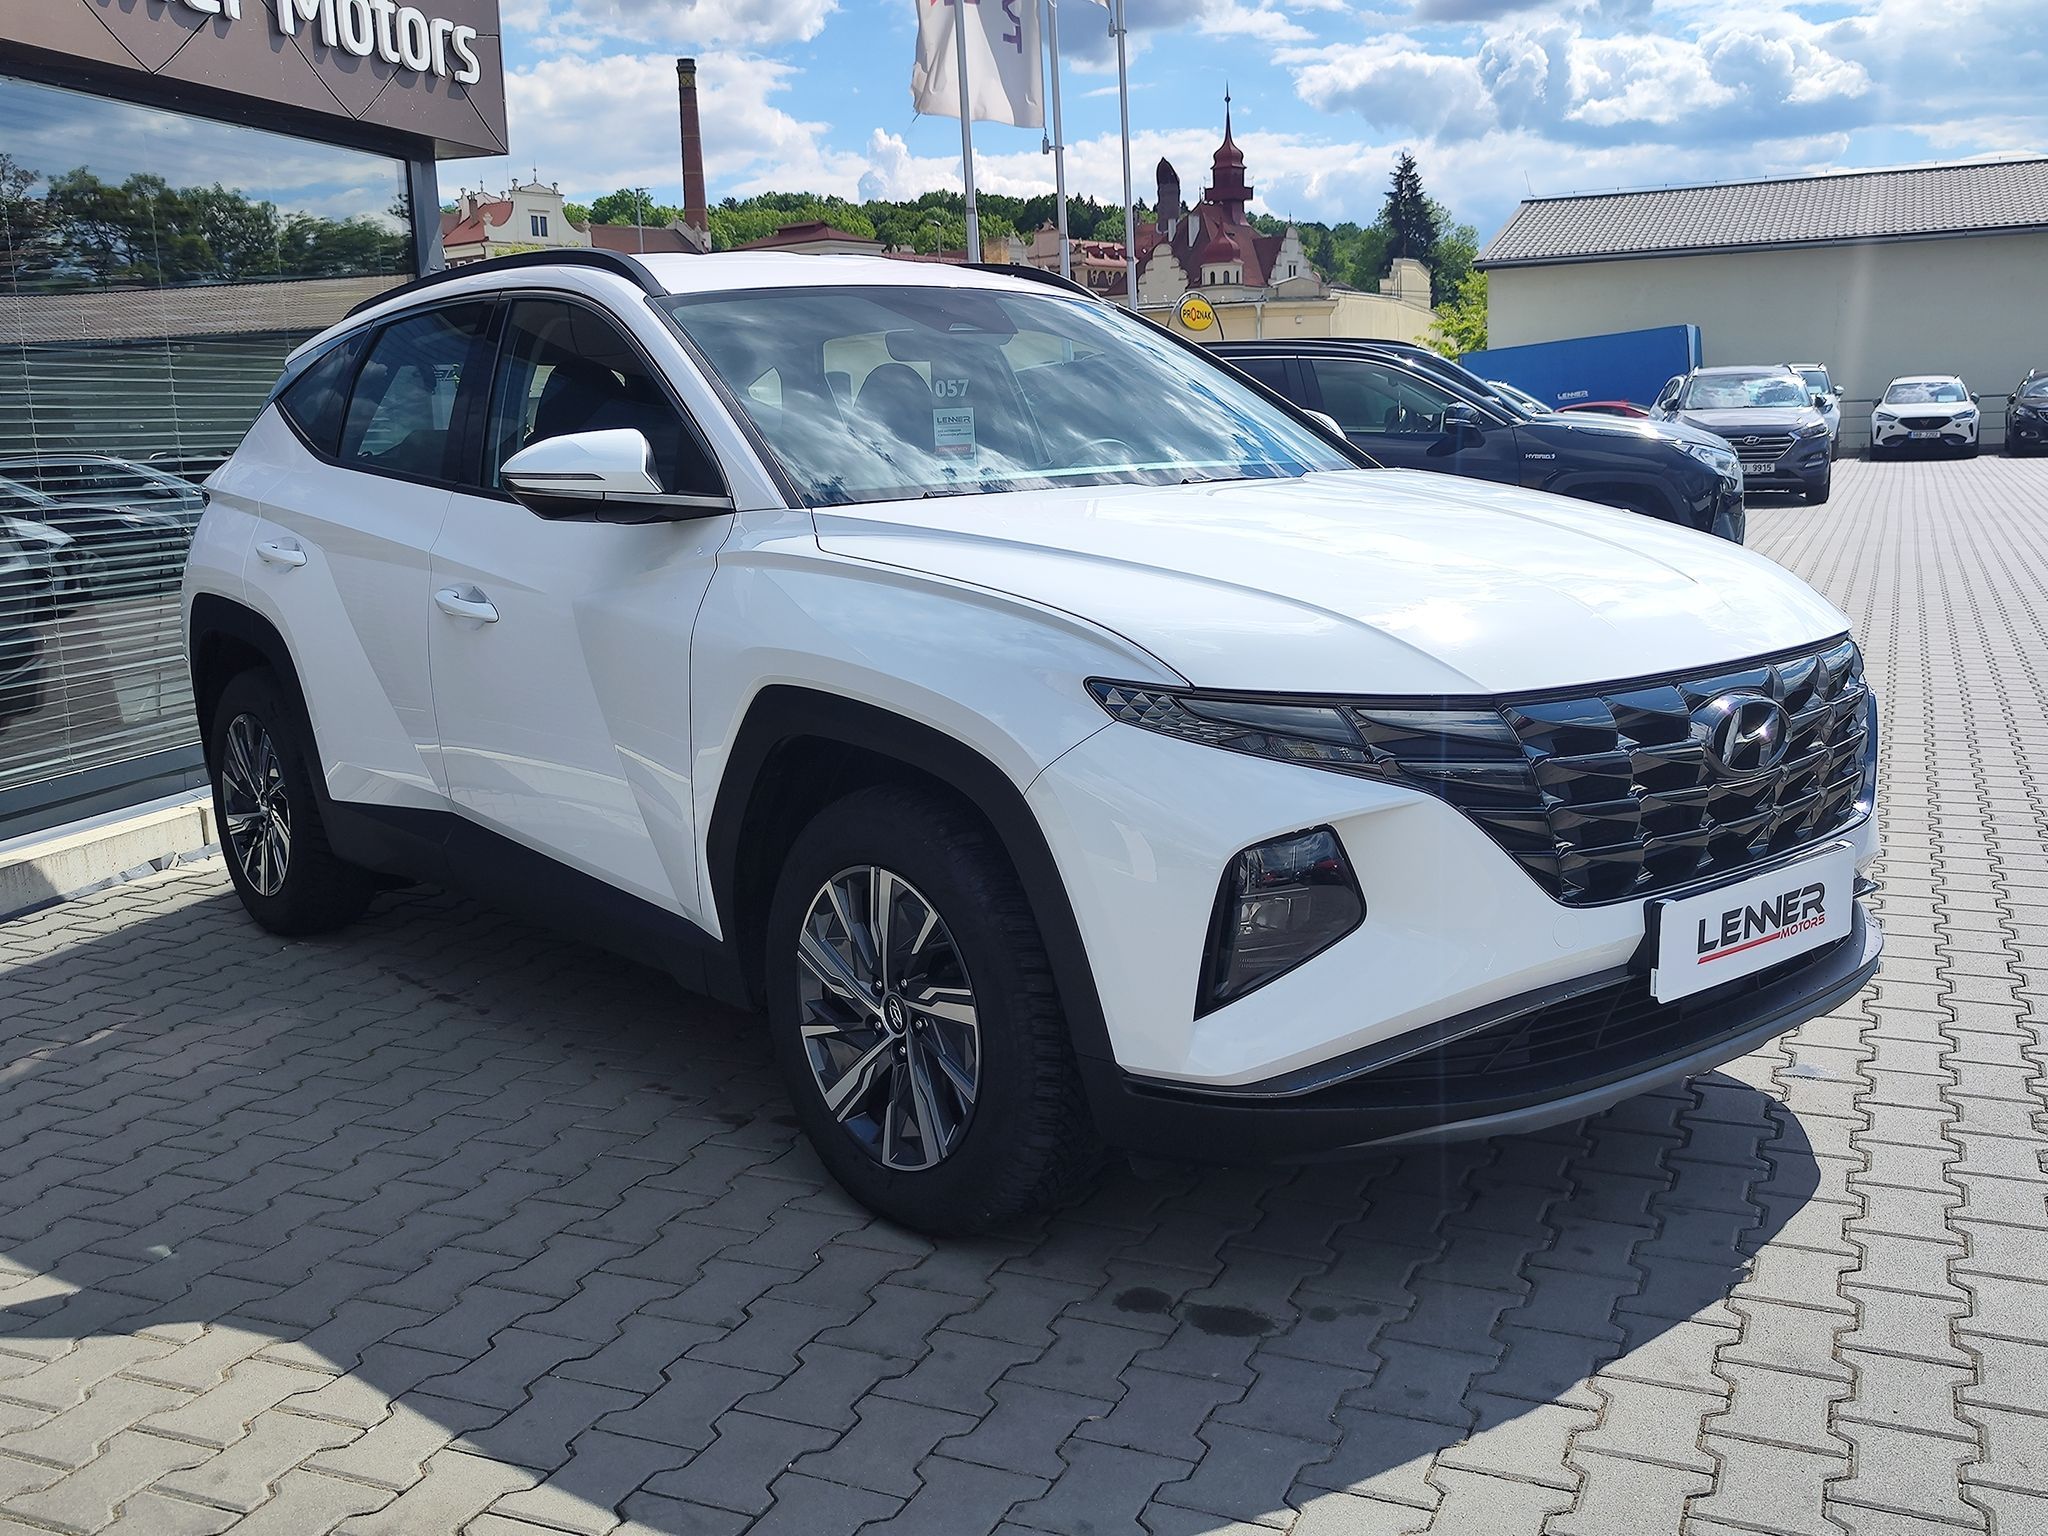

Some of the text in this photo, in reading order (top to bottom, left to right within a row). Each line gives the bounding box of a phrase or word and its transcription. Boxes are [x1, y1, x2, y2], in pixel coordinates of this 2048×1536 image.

[278, 0, 481, 85] Motors
[935, 379, 969, 398] 057
[1697, 882, 1825, 954] LENNER
[1780, 914, 1825, 939] MOTORS
